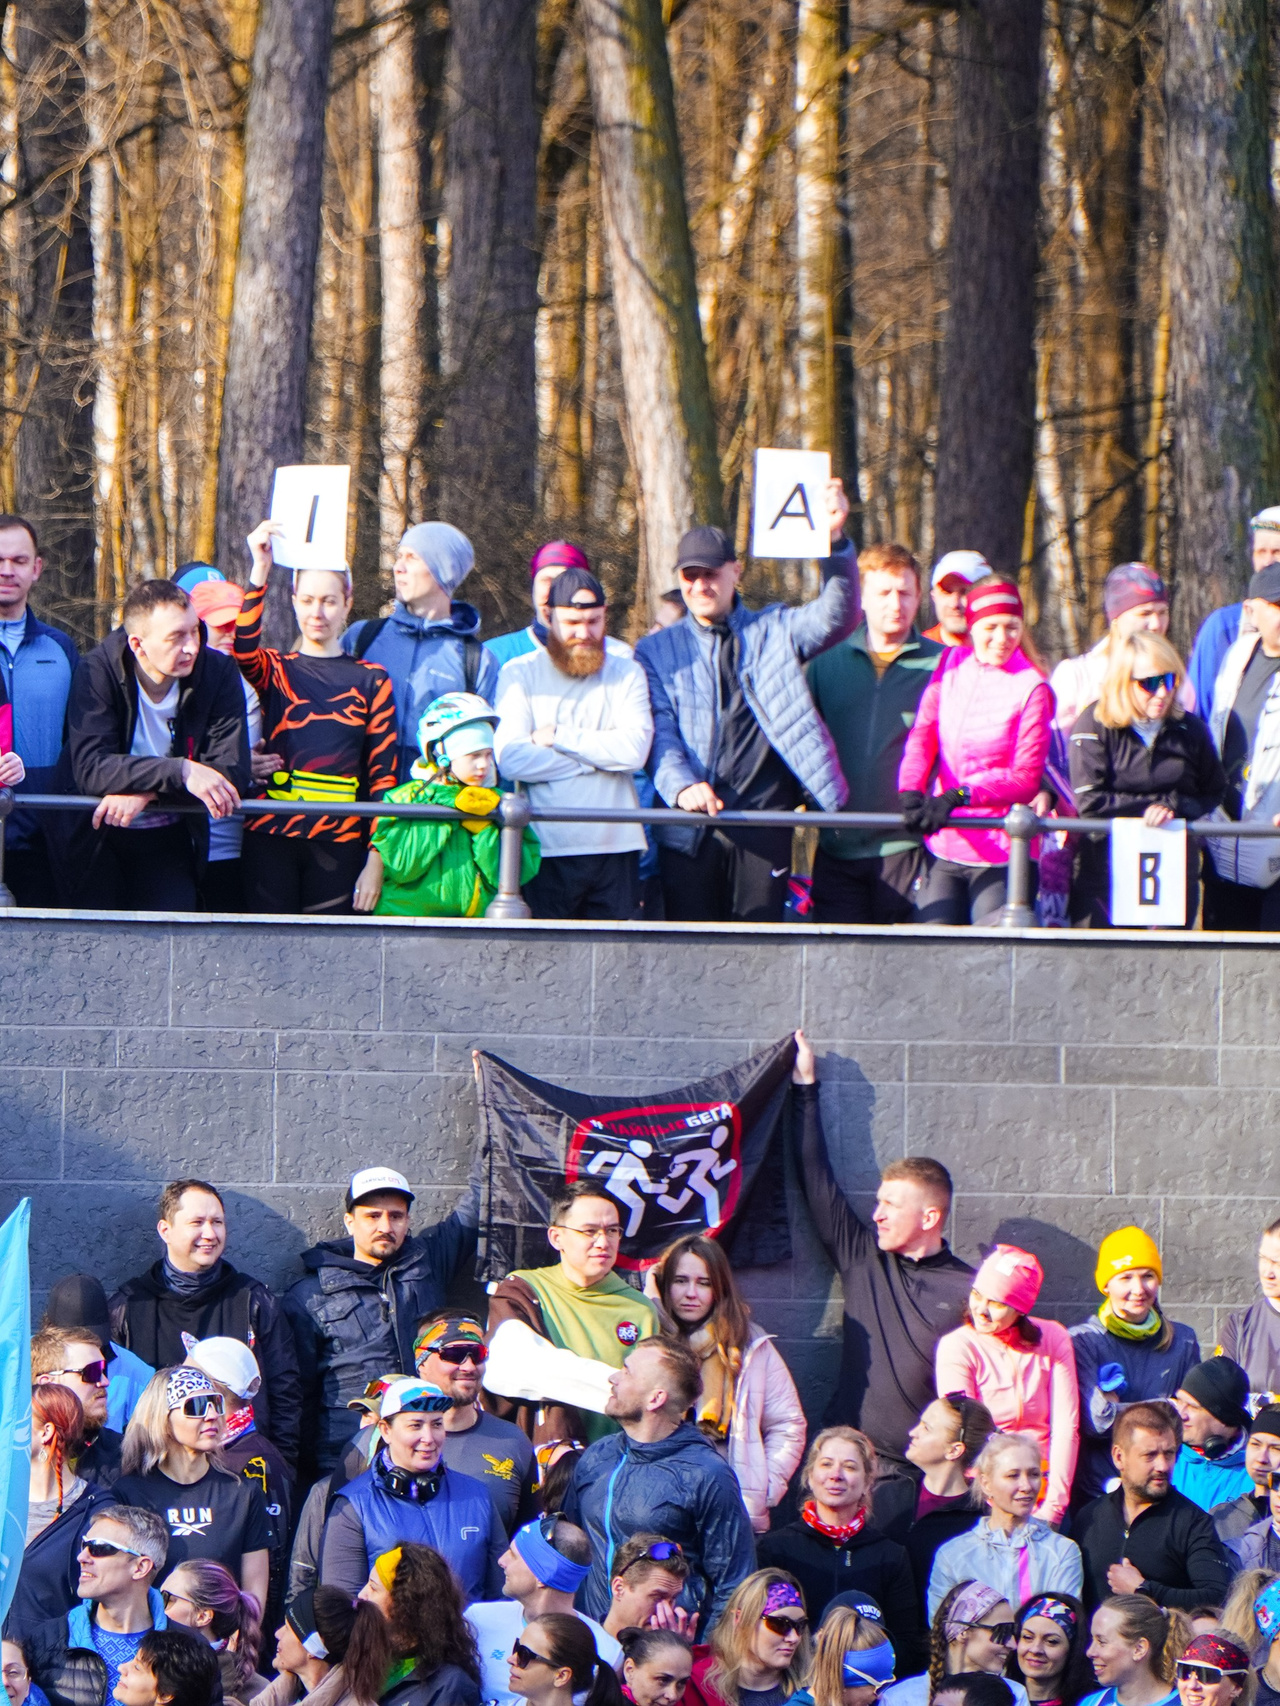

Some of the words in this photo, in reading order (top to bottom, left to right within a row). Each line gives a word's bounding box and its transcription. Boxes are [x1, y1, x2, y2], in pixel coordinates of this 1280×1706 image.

[768, 483, 816, 531] A
[1138, 852, 1162, 906] B
[167, 1507, 213, 1523] RUN
[855, 1604, 881, 1618] TOKYO
